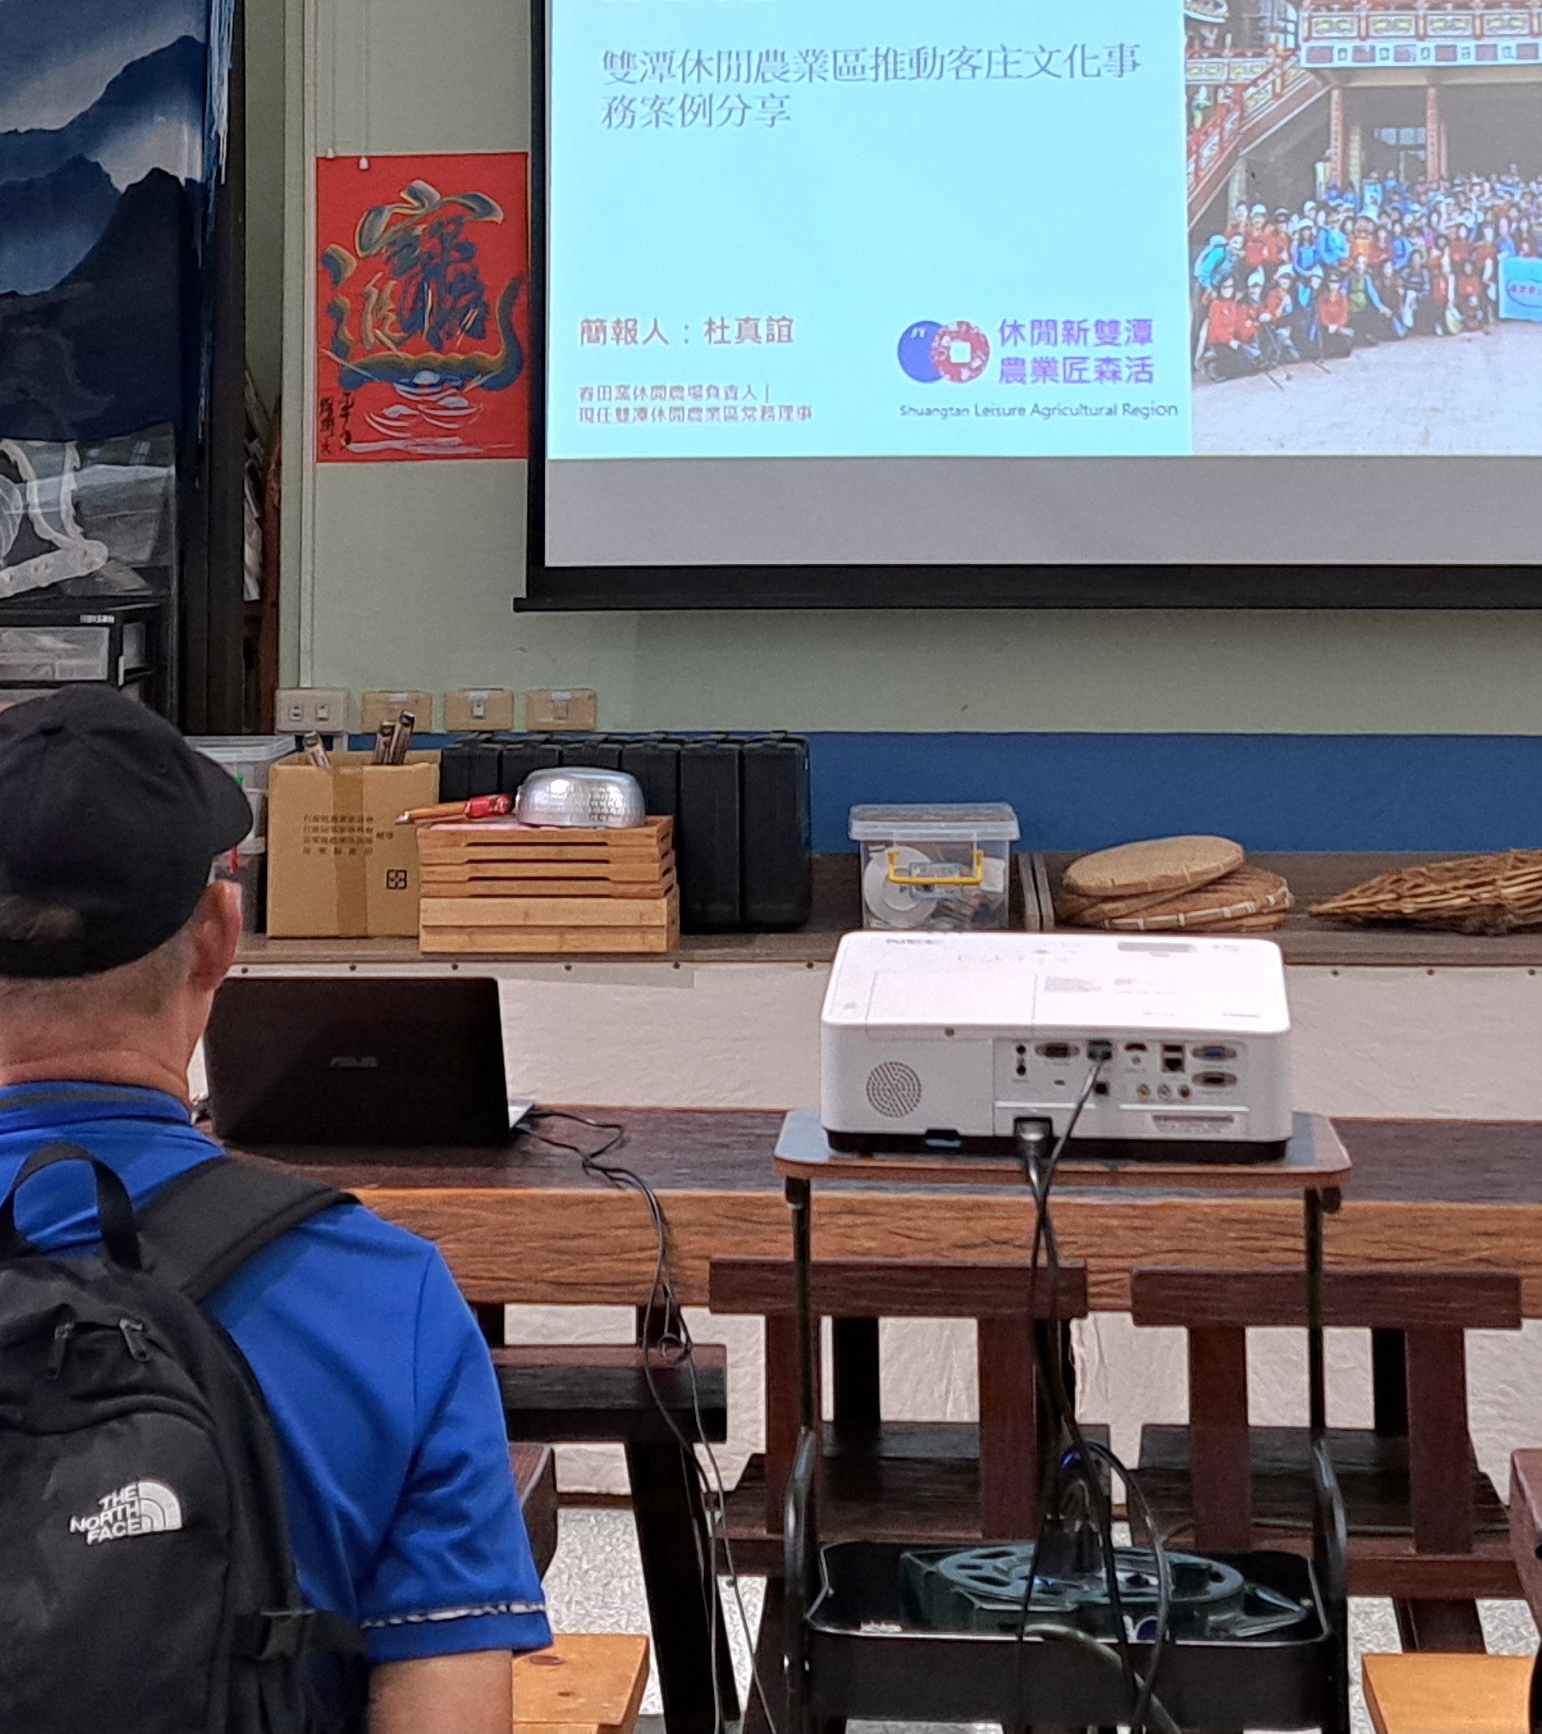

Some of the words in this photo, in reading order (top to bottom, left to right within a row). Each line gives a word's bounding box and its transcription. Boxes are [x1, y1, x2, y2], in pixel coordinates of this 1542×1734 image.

[600, 42, 1142, 86] 雙潭休閒農業區推動客庄文化事
[600, 91, 792, 130] 務案例分享
[997, 317, 1154, 348] 休閒新雙潭
[997, 355, 1155, 385] 農業匠森活
[899, 404, 970, 419] Shuangtan
[974, 403, 1027, 417] Leisure
[1030, 402, 1118, 420] Agricultural
[1122, 399, 1179, 420] Region
[97, 1484, 138, 1510] THE
[68, 1498, 140, 1533] NORTH
[85, 1517, 143, 1546] FACE
